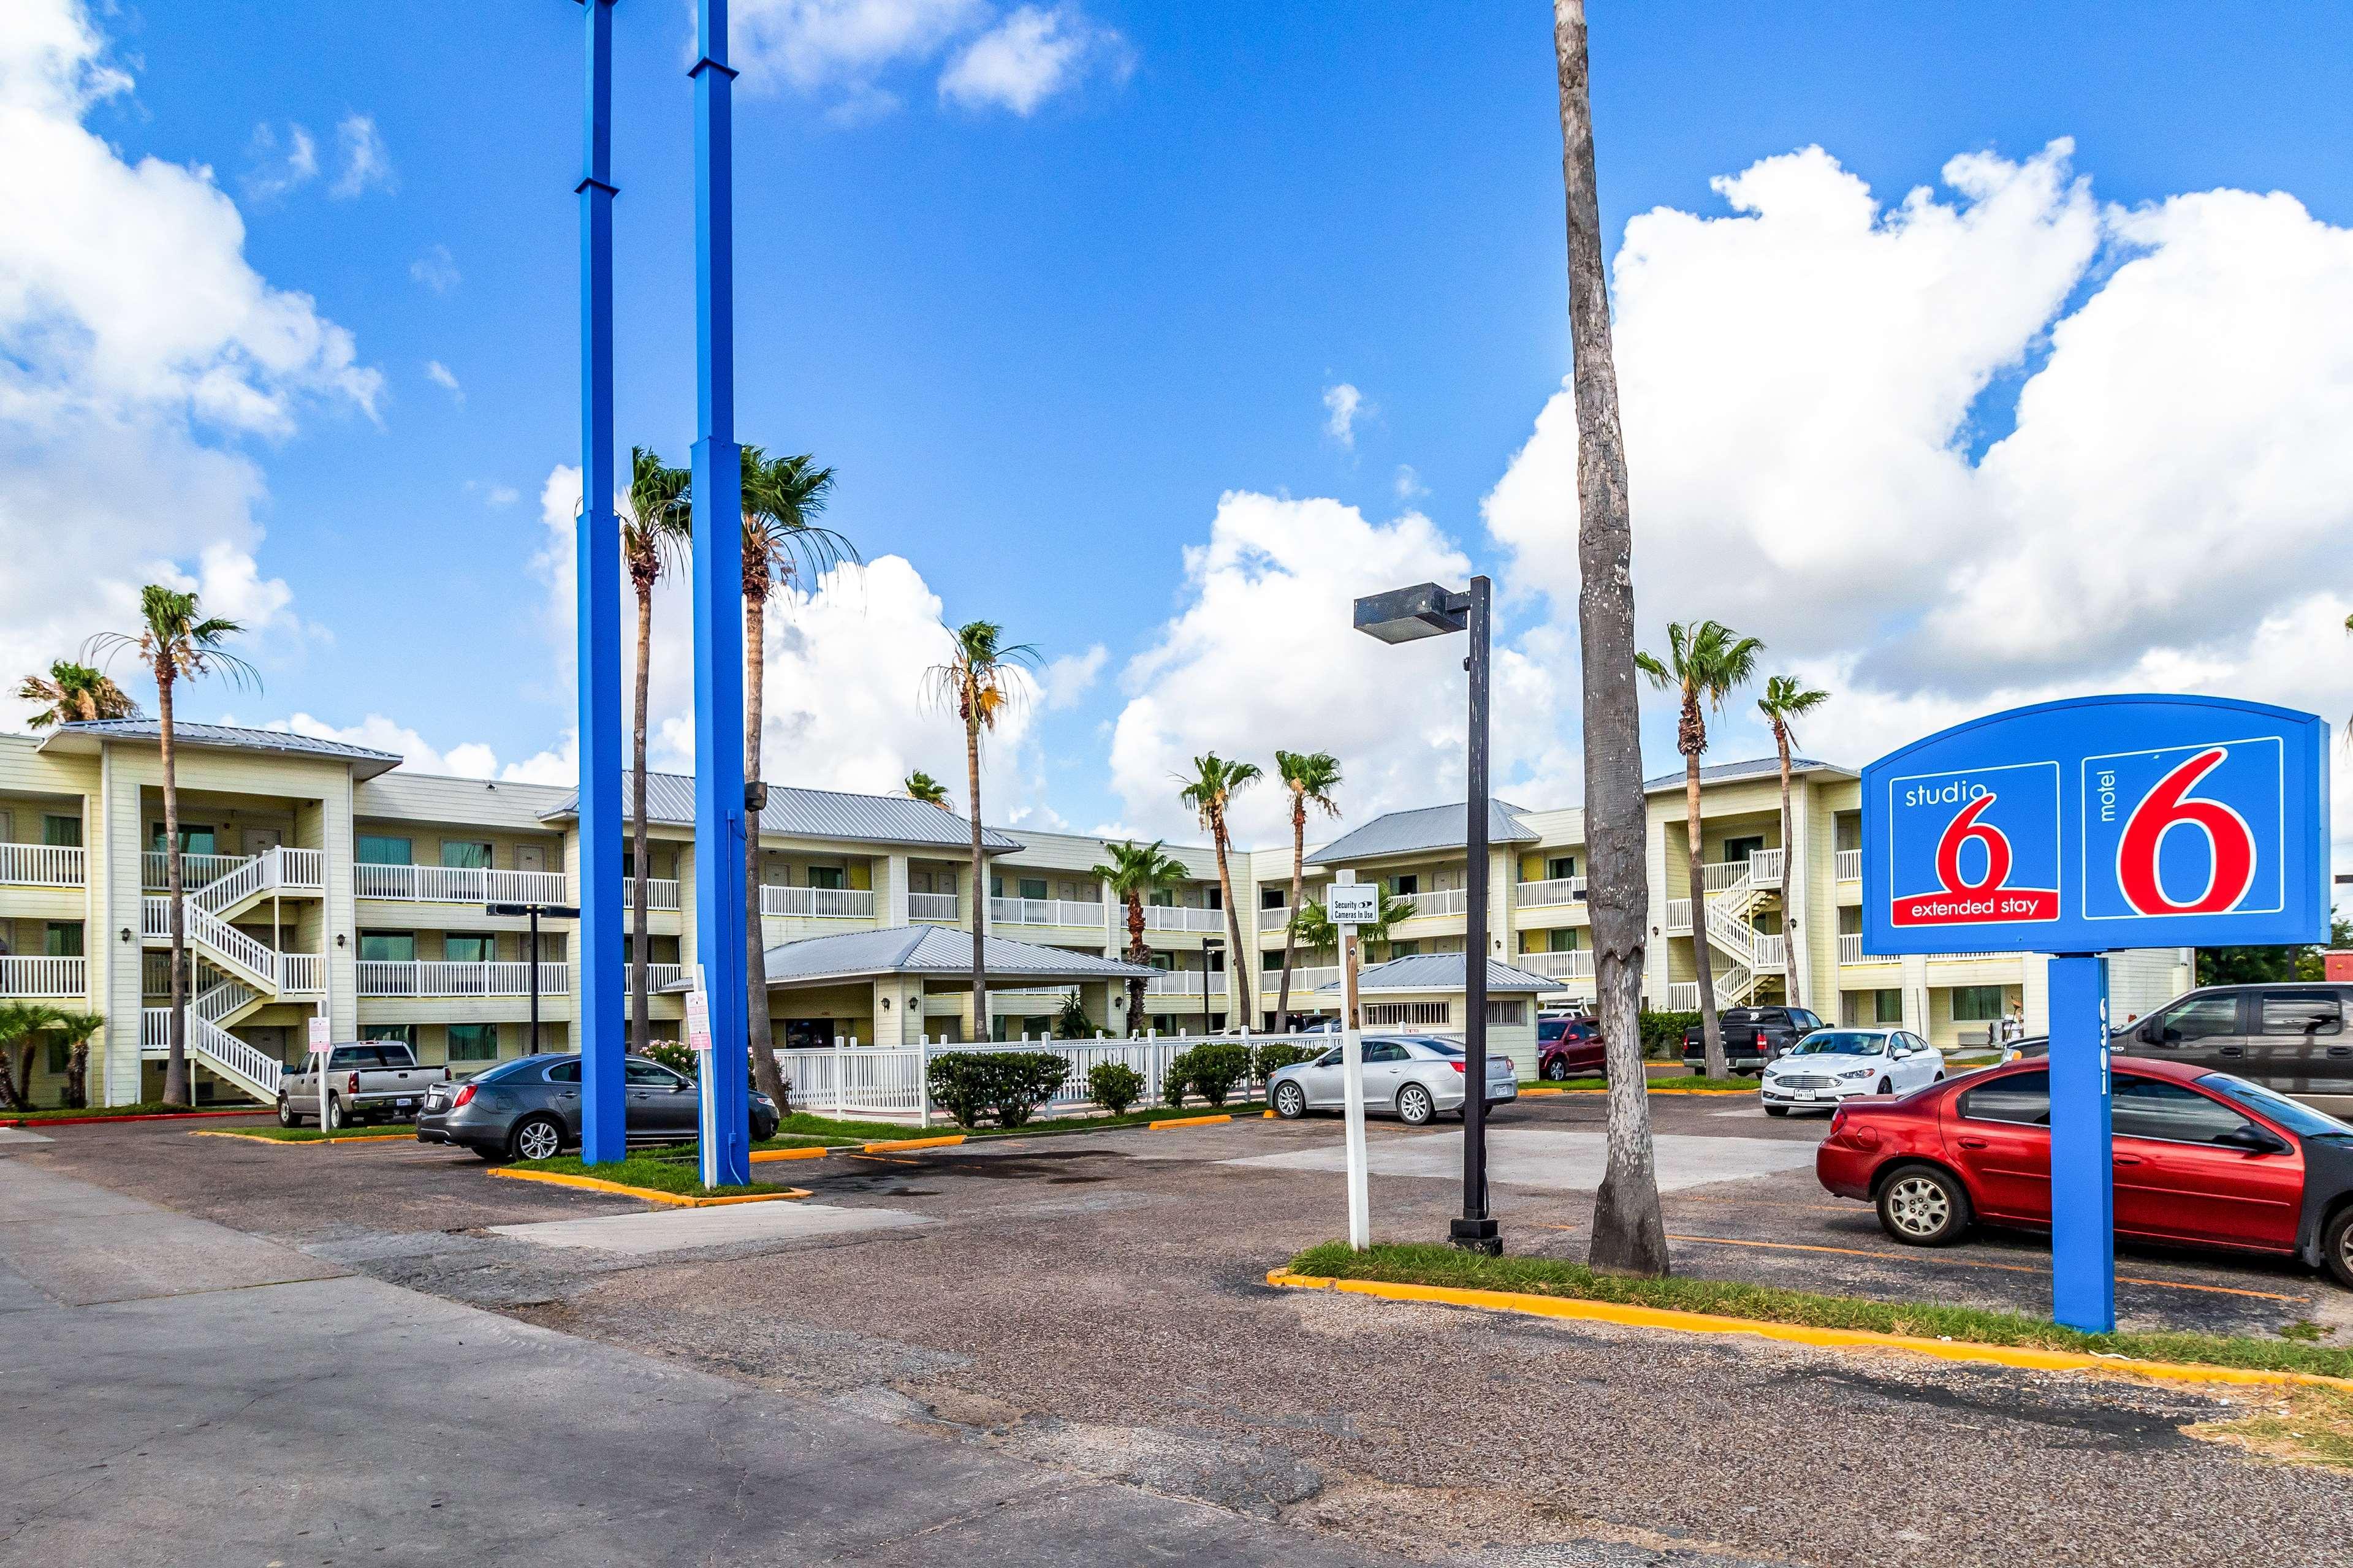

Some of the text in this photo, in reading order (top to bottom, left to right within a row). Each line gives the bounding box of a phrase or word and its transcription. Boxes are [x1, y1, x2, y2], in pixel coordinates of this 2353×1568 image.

[1906, 781, 1987, 806] studio
[2097, 770, 2115, 822] motel
[1936, 792, 2013, 895] 6
[2116, 747, 2257, 916] 6
[1335, 901, 1357, 910] Security
[1911, 899, 2039, 917] extended stay
